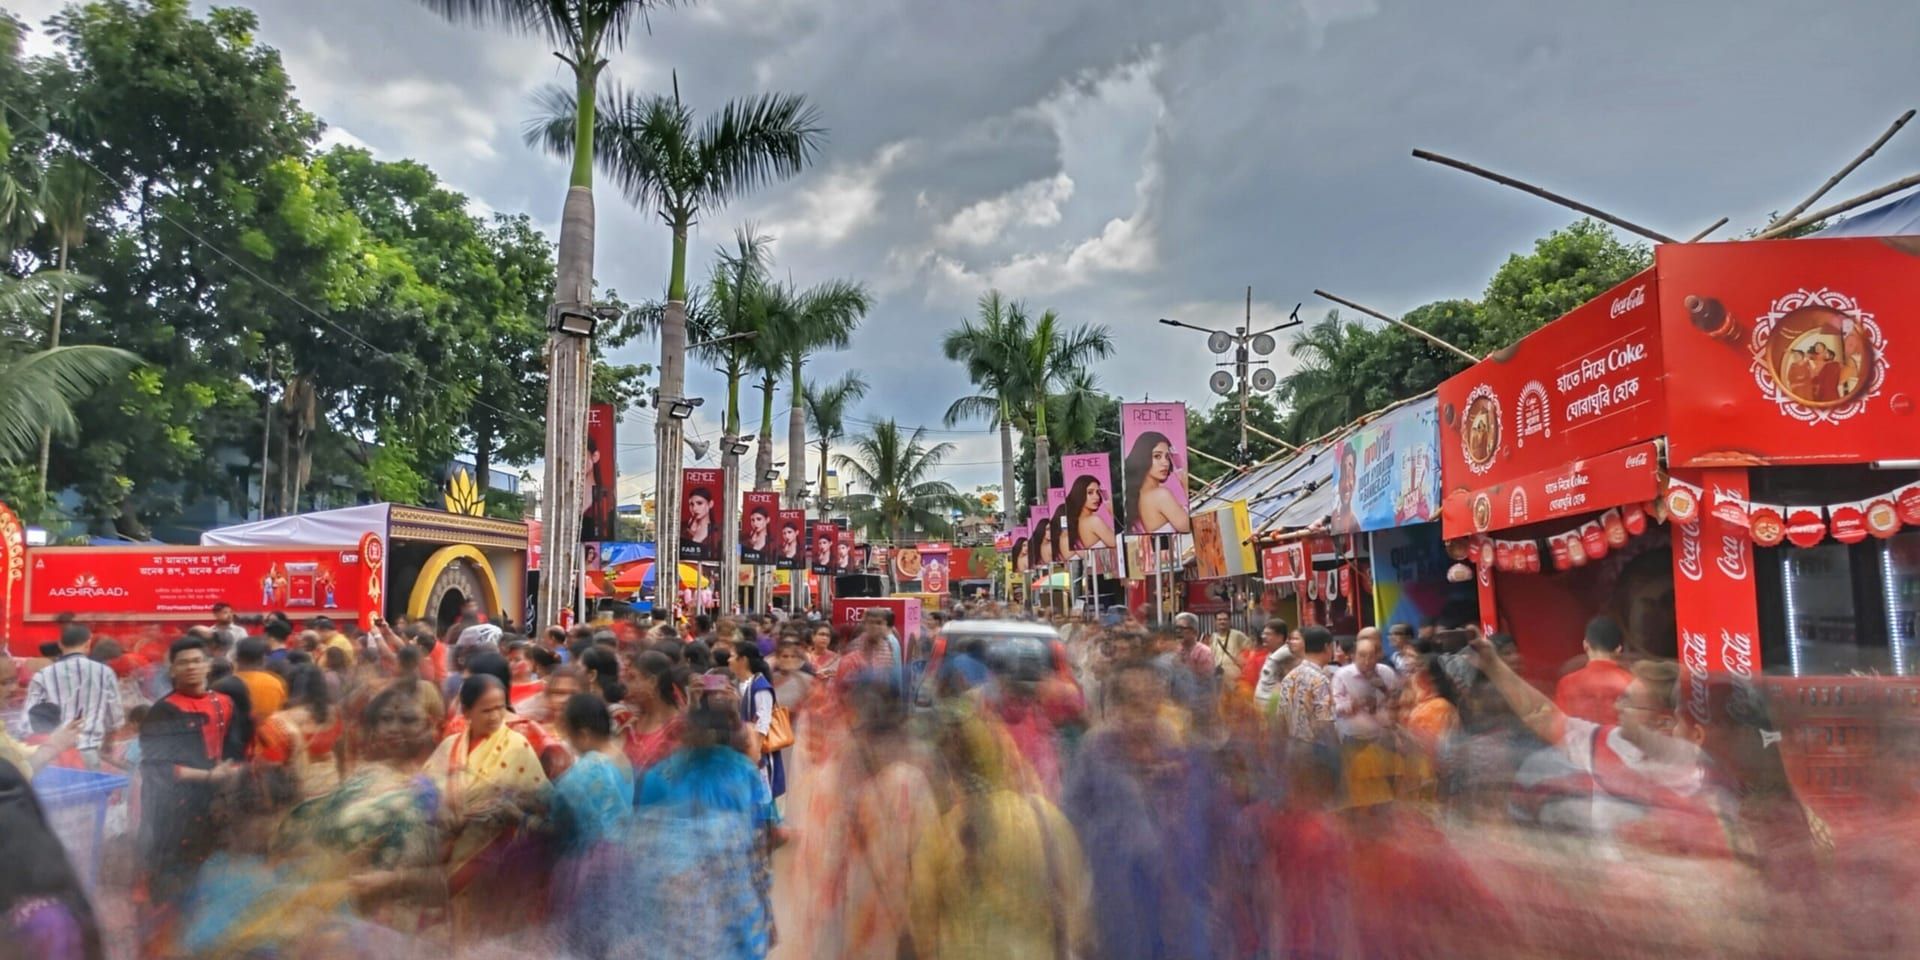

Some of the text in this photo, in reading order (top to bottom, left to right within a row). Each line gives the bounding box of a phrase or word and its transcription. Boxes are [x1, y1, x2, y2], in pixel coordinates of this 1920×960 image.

[1557, 369, 1580, 393] হাতে
[1581, 359, 1606, 383] নিয়ে
[1613, 377, 1640, 404] হোক
[1132, 408, 1173, 422] RENEE
[1070, 457, 1100, 469] RENEE
[686, 471, 716, 482] RENEE
[749, 494, 772, 503] RENEE
[48, 587, 124, 598] AASHIRVAAD
